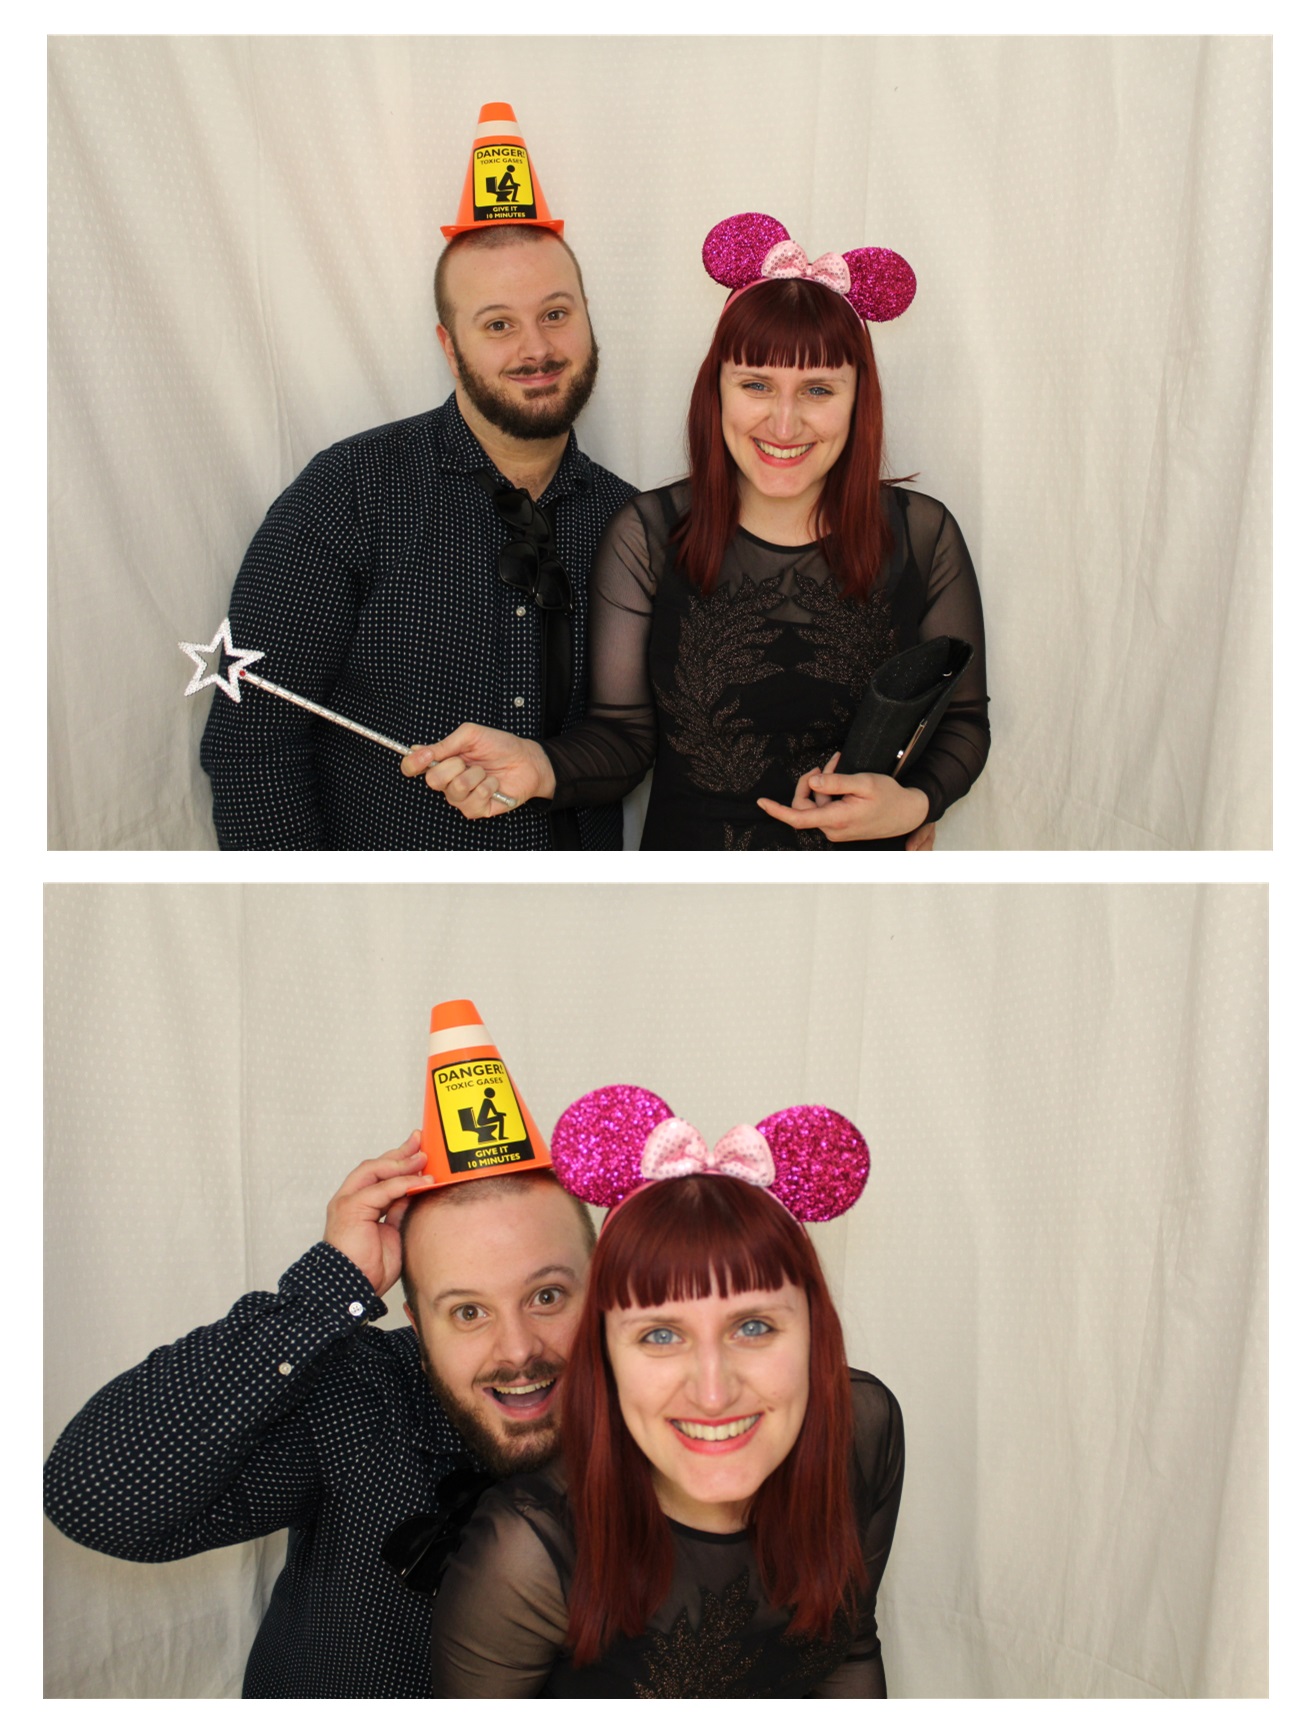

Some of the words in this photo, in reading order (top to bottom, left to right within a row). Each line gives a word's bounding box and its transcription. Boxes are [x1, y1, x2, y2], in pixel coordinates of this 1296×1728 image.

[476, 148, 525, 159] DANGER!
[438, 1063, 504, 1084] DANGER!
[445, 1081, 475, 1092] TOXIC
[476, 1077, 503, 1086] GASES
[475, 1147, 498, 1158] GIVE
[499, 1145, 509, 1153] IT
[467, 1160, 477, 1169] 10
[479, 1153, 521, 1167] MINUTES
